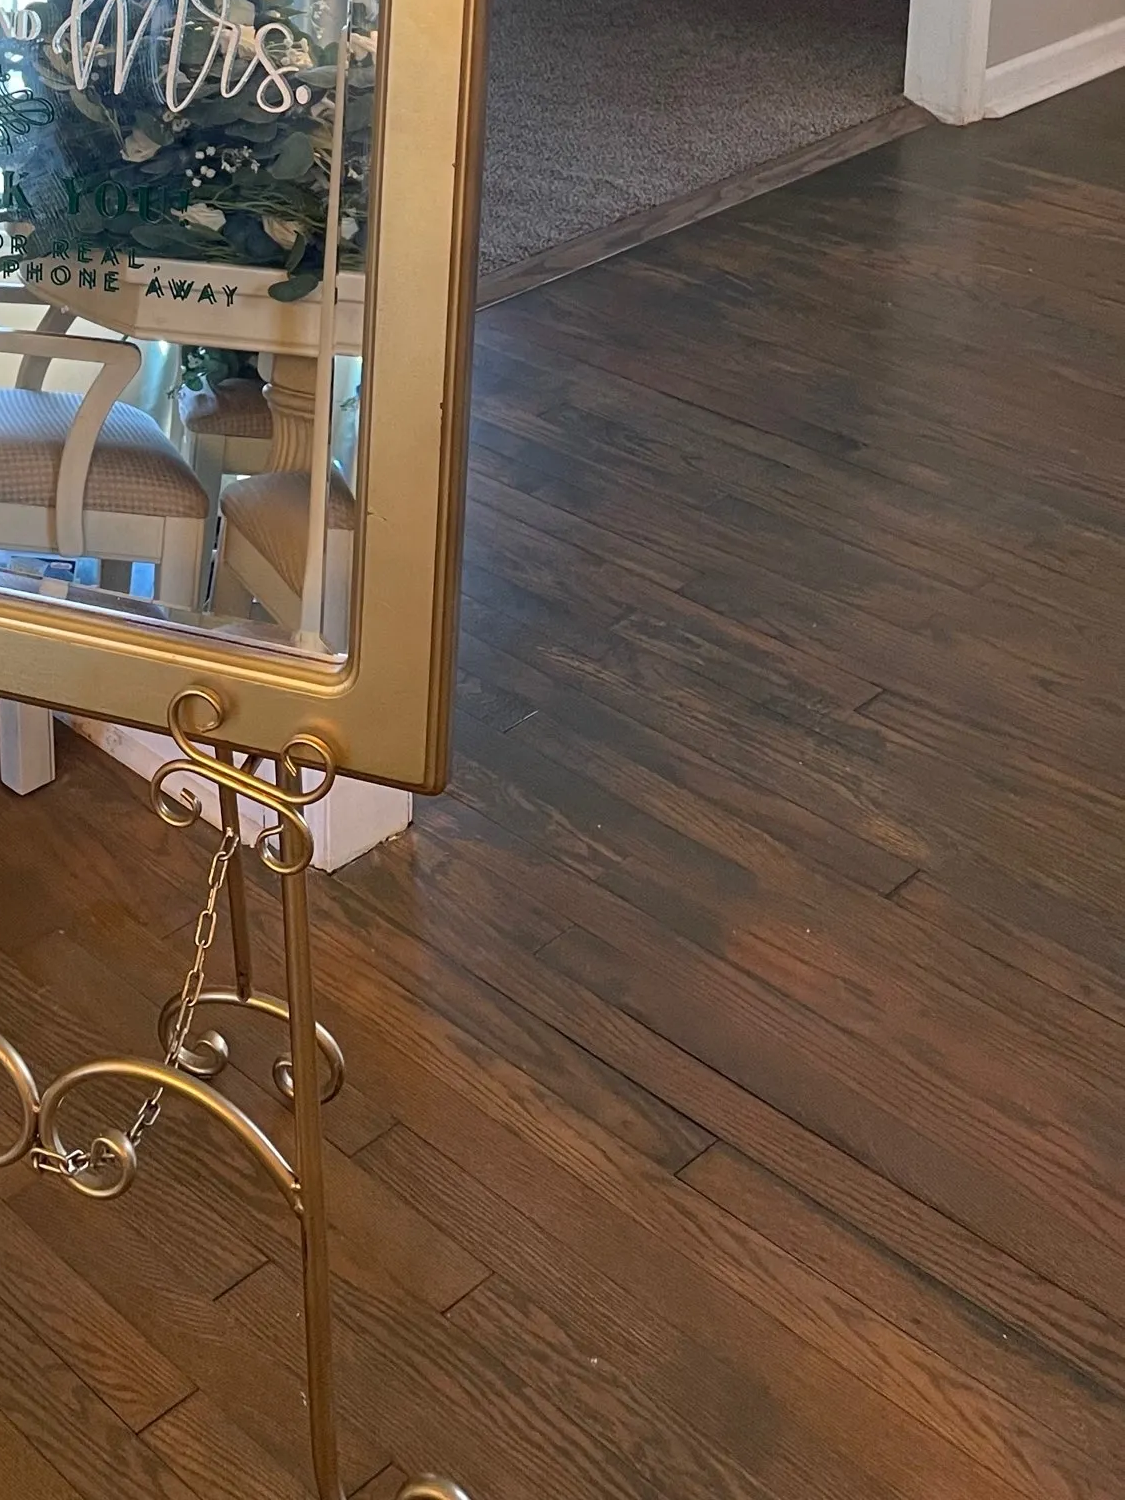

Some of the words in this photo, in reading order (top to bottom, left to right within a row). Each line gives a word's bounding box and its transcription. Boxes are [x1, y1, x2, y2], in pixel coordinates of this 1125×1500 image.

[52, 235, 160, 273] REAL,
[3, 258, 121, 293] PHONE
[145, 276, 239, 308] AWAY
